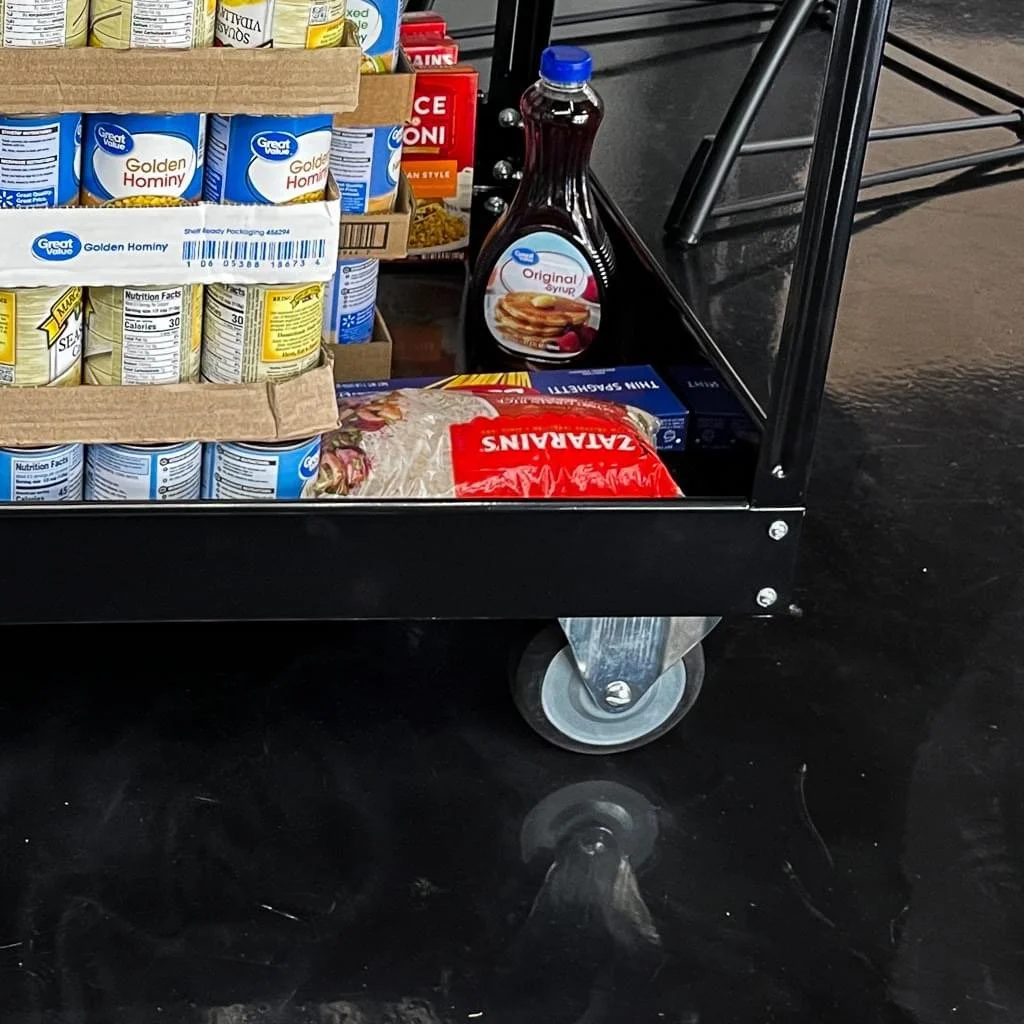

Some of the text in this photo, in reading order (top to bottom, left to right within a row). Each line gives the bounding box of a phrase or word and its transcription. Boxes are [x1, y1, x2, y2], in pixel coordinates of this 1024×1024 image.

[413, 54, 453, 66] AINS
[98, 126, 126, 145] Great
[403, 126, 445, 145] ONI
[103, 138, 126, 151] Value
[256, 137, 291, 149] Great
[264, 146, 290, 156] Value
[126, 157, 186, 174] Golden
[123, 172, 186, 189] Hominy
[422, 170, 450, 179] STYLE
[37, 238, 74, 249] Great
[83, 242, 169, 252] Golden Hominy
[46, 246, 73, 255] Value
[522, 268, 577, 285] Original
[126, 289, 181, 301] Nutrition Facts
[545, 284, 576, 296] Syrup
[124, 316, 181, 330] Calories 30
[231, 314, 244, 325] 30
[548, 379, 660, 394] THIN SPAGHETTI
[480, 431, 636, 452] ZATARAIN'S
[16, 456, 69, 472] Nutrition Facts
